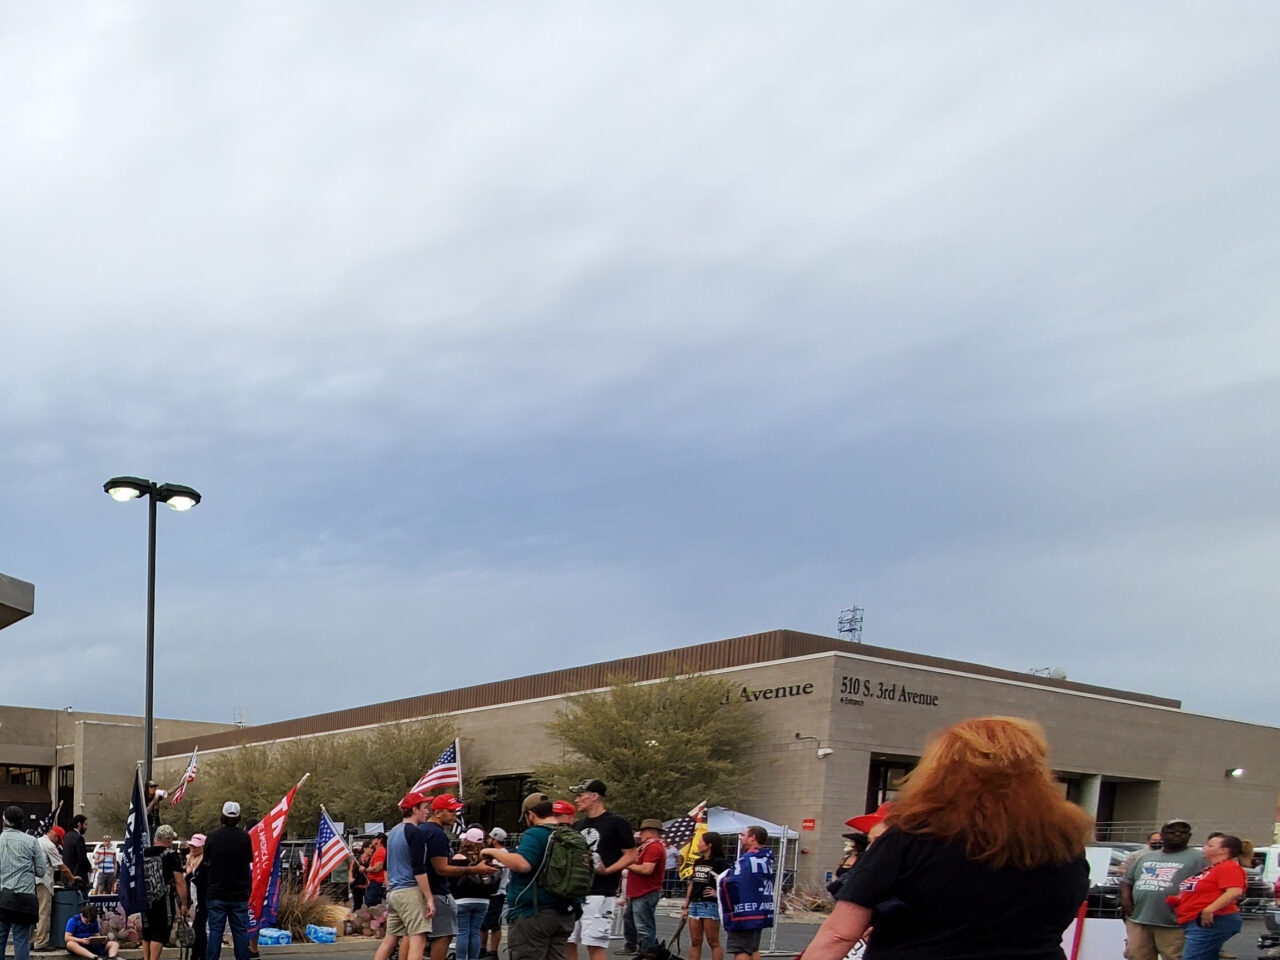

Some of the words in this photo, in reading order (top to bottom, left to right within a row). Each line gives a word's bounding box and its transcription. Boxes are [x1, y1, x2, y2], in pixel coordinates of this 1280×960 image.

[740, 682, 814, 702] Avenue
[840, 676, 860, 696] 510
[863, 679, 873, 698] S.
[876, 682, 896, 701] 3rd
[898, 685, 939, 706] Avenue
